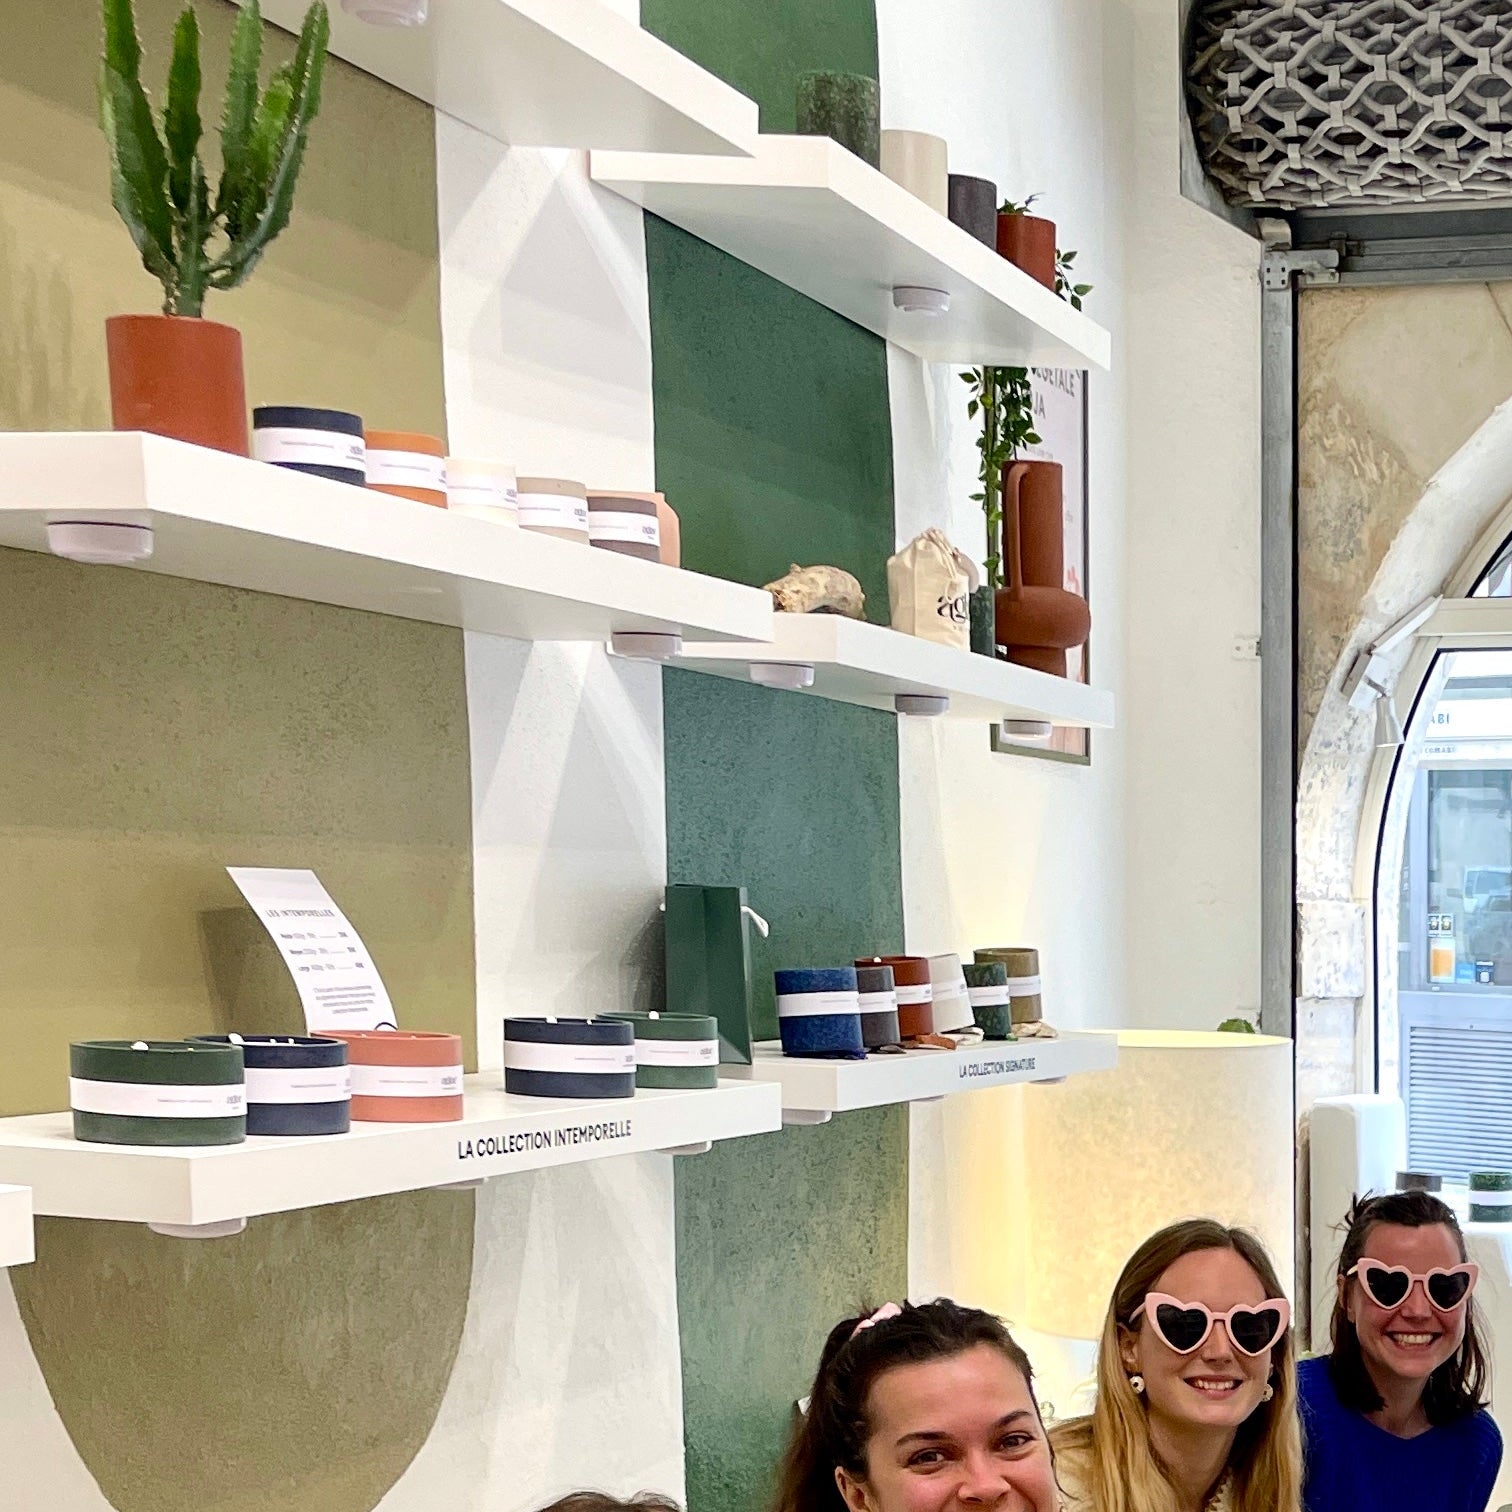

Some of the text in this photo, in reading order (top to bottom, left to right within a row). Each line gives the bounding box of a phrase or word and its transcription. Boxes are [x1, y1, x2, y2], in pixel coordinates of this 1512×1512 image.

[959, 1064, 967, 1078] LA
[968, 1061, 1004, 1077] COLLECTION
[458, 1119, 632, 1159] LA COLLECTION INTEMPORELLE
